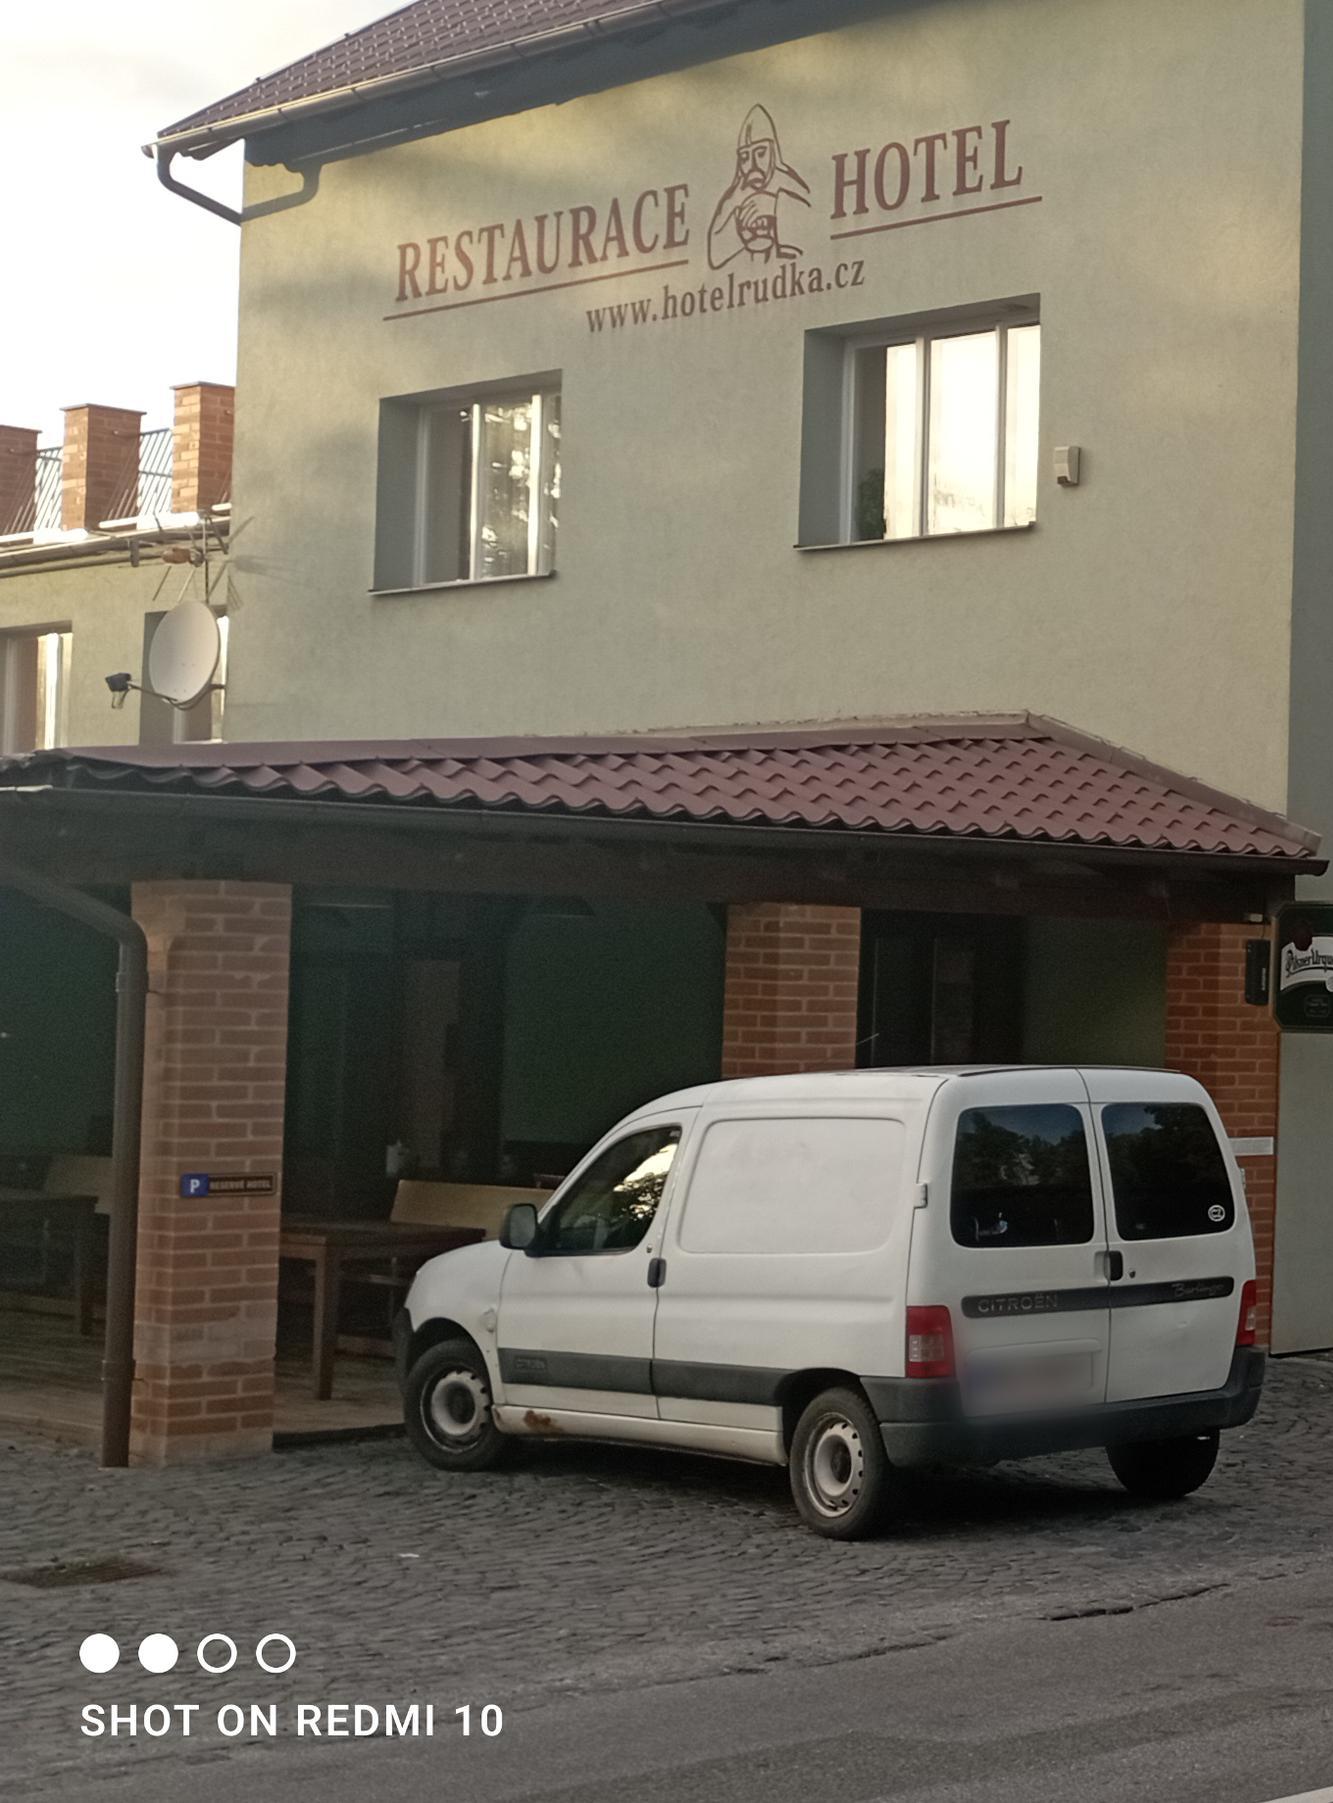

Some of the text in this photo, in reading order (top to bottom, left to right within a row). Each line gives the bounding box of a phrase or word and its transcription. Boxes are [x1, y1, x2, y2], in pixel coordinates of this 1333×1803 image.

[395, 119, 1022, 302] RESTAURACE HOTEL
[585, 258, 865, 333] www.hotelrudka.cz
[189, 1179, 201, 1194] P
[977, 1293, 1057, 1313] CITROËN
